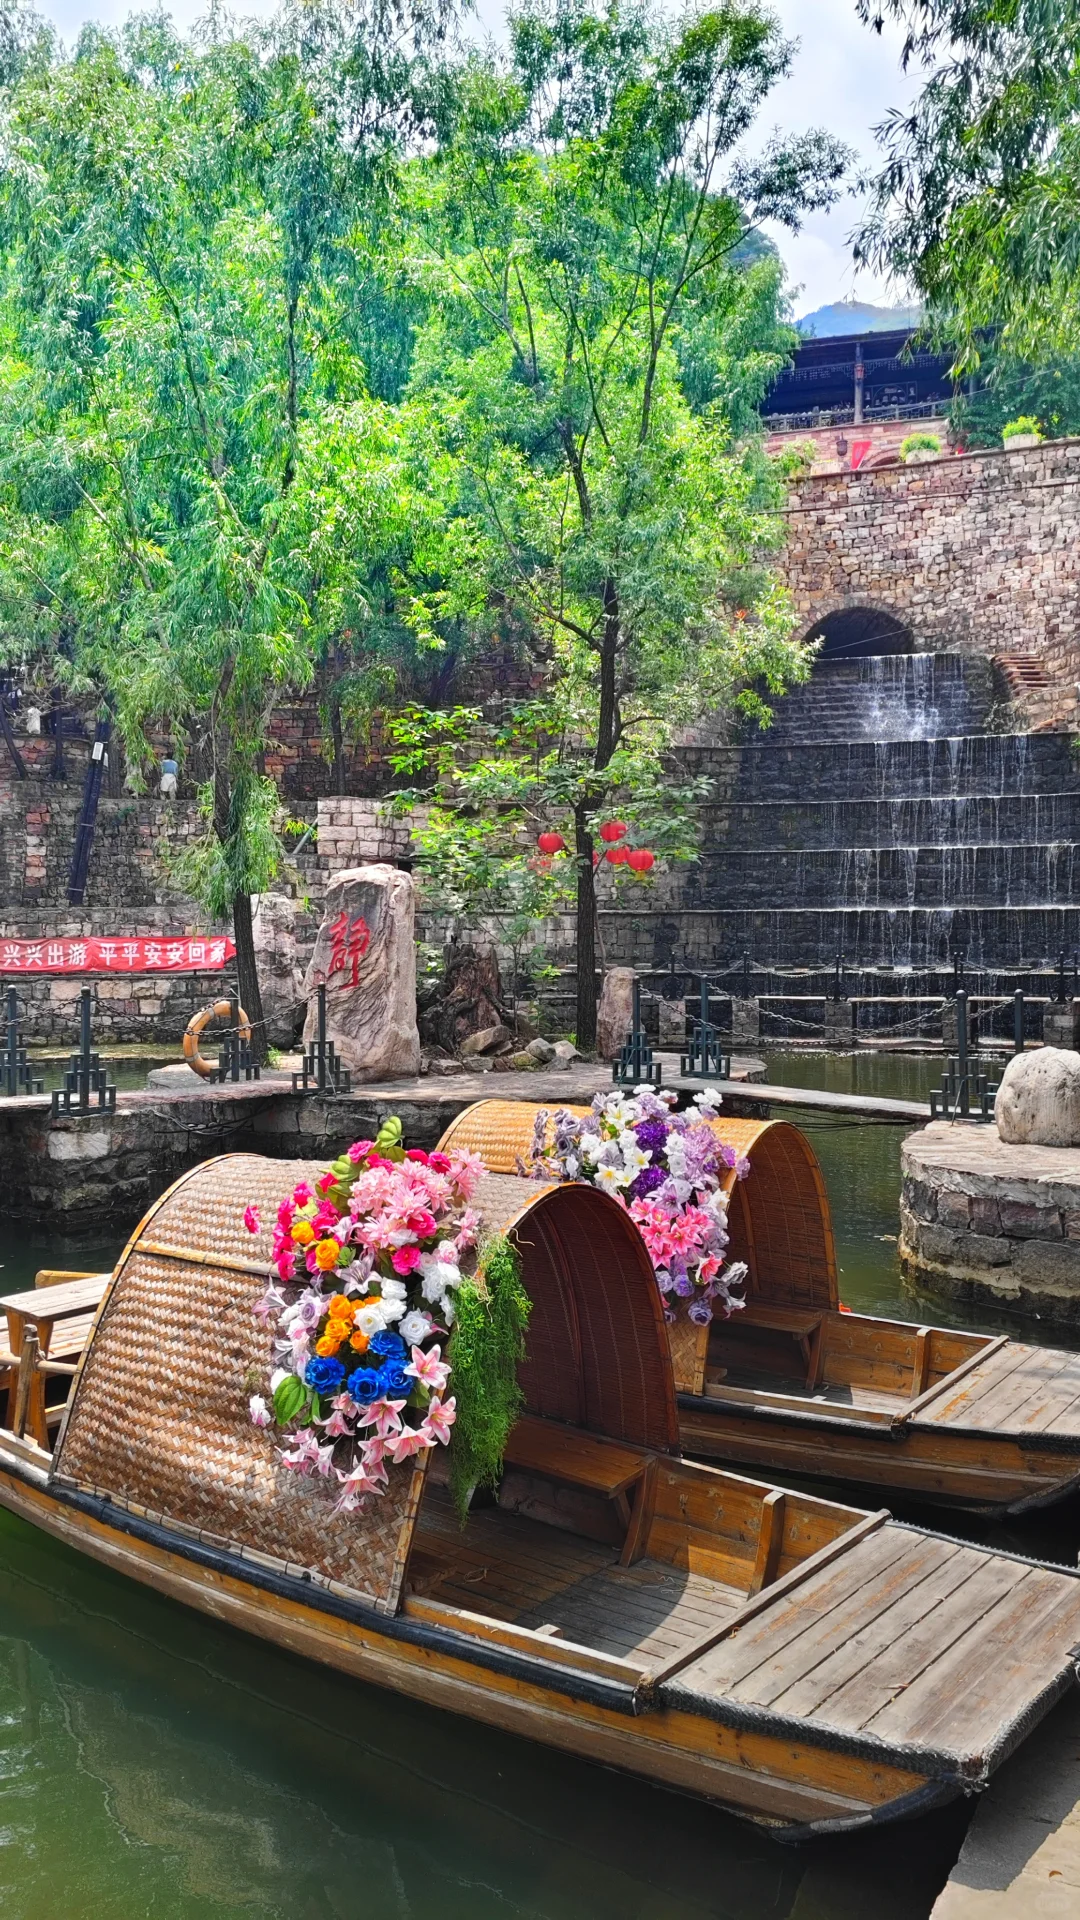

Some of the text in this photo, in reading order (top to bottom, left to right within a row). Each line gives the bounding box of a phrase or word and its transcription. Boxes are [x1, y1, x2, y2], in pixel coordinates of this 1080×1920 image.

[3, 942, 226, 967] 兴兴出游 平平安安回家
